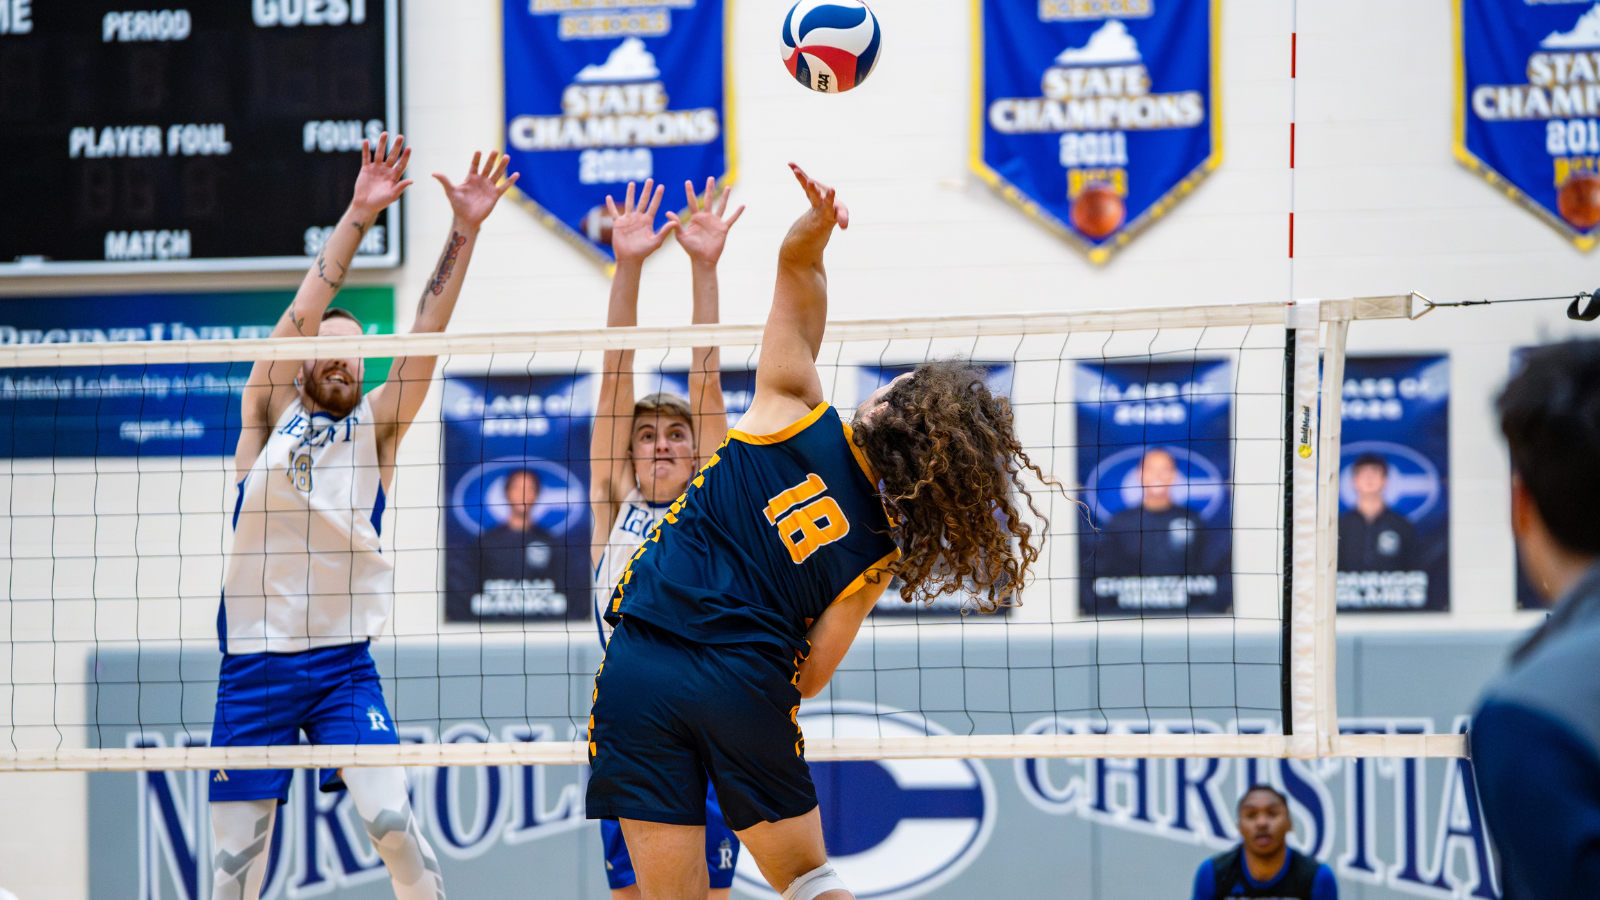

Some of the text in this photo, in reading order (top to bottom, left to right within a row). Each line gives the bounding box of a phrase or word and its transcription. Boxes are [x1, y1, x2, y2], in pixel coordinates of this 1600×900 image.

[102, 9, 191, 42] PERIOD
[562, 82, 666, 115] STATE
[1043, 66, 1150, 99] STATE
[989, 91, 1204, 133] CHAMPIONS
[69, 123, 232, 158] PLAYER FOUL
[302, 119, 384, 152] FOULS
[509, 109, 719, 150] CHAMPIONS
[1059, 132, 1128, 167] 2011
[104, 230, 191, 260] MATCH
[763, 473, 850, 564] 18
